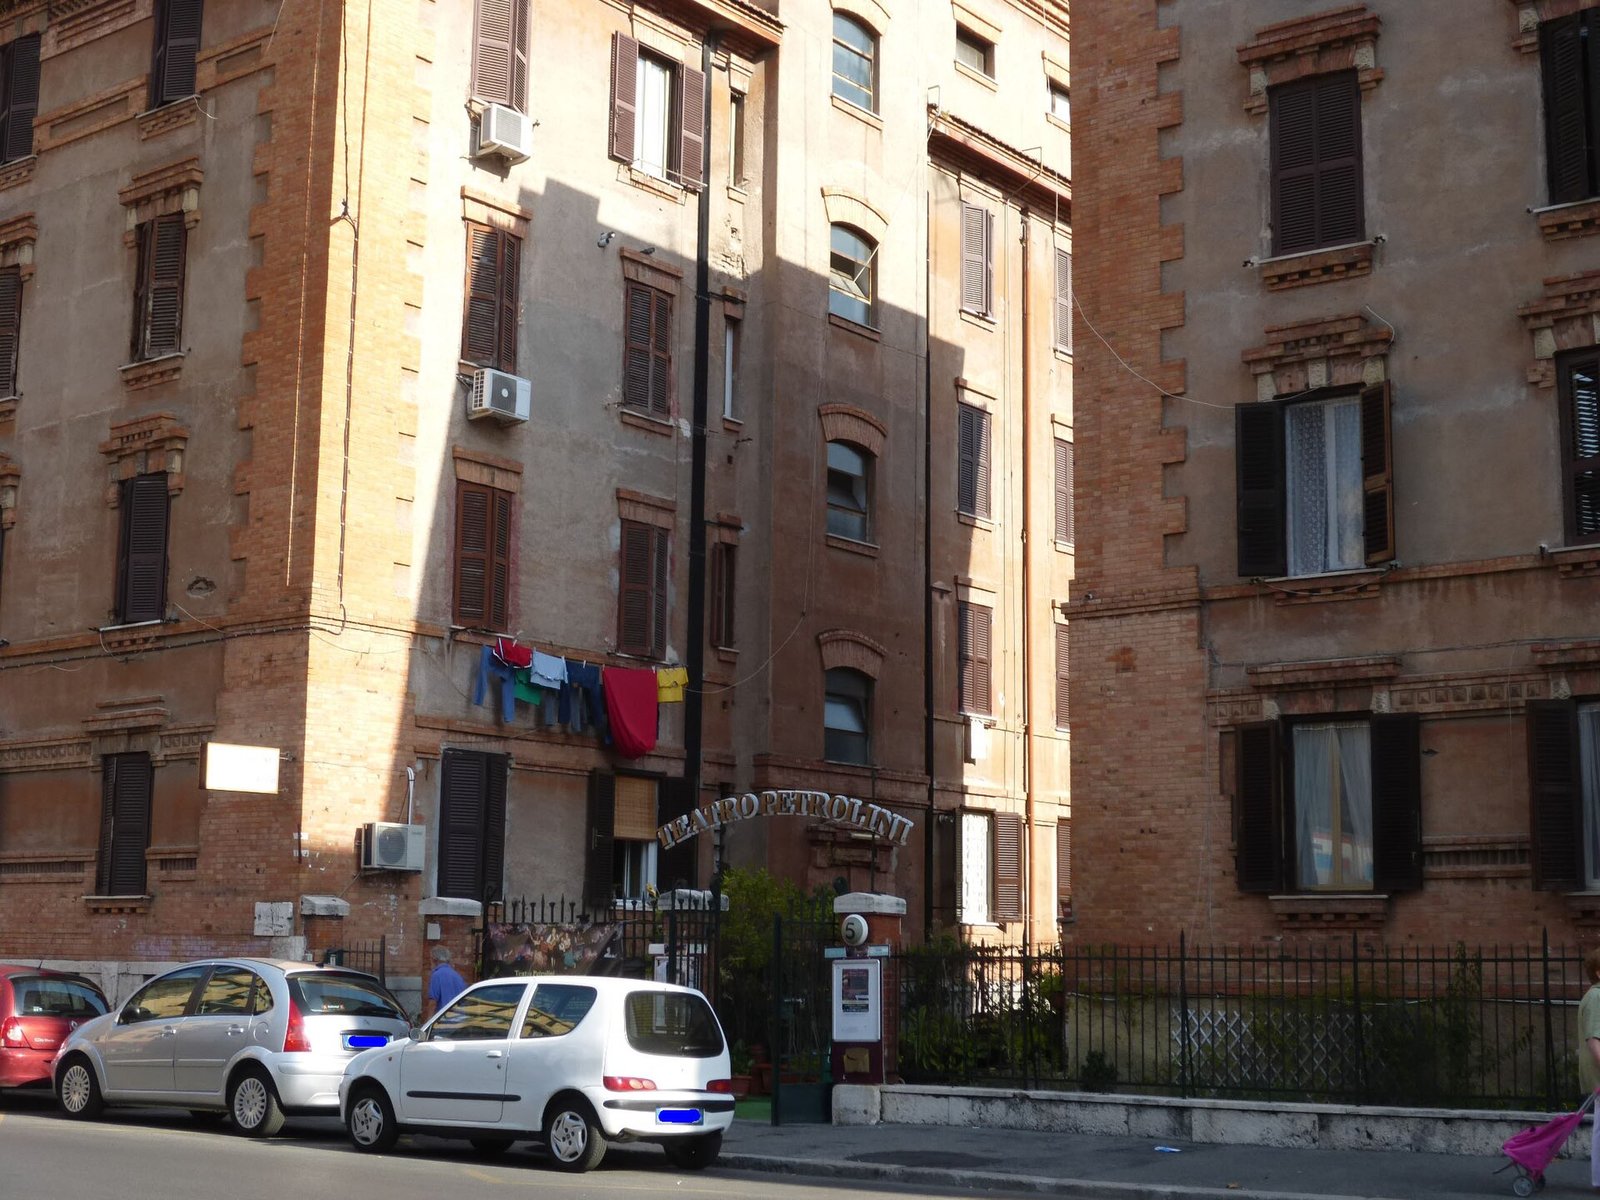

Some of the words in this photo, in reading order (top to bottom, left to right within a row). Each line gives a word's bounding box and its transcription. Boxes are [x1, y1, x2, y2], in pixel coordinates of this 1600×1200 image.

[657, 793, 759, 850] TEATRO
[762, 790, 914, 846] PETROLINI
[845, 922, 856, 940] 5
